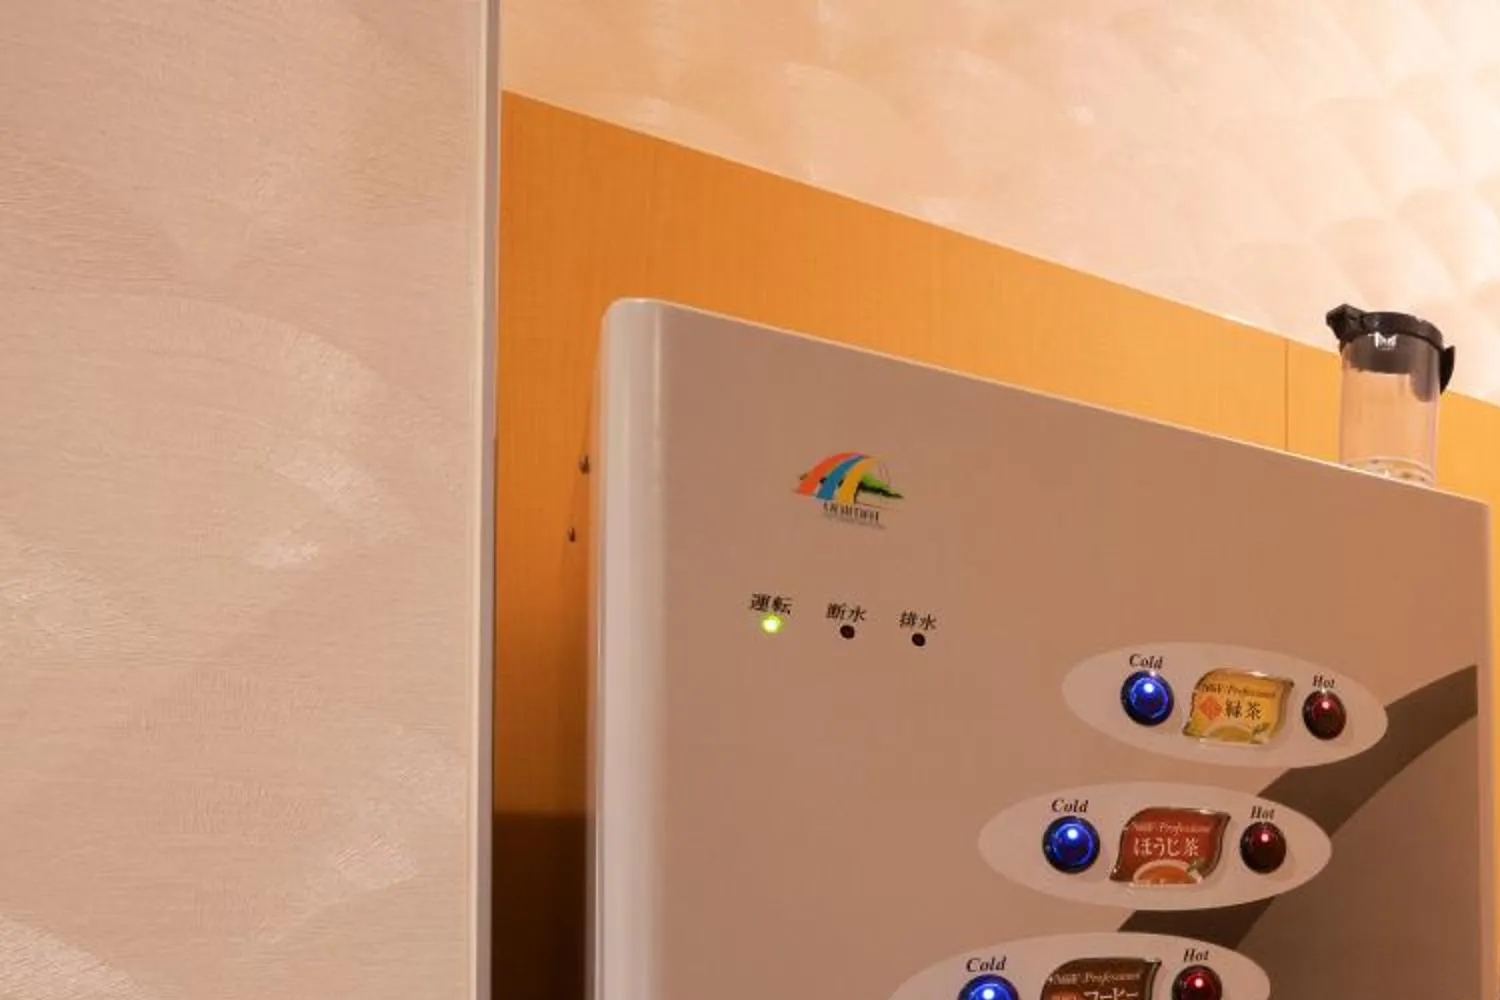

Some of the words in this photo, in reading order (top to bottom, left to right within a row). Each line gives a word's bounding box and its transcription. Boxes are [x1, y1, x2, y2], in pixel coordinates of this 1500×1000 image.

[748, 593, 793, 615] 運転
[826, 602, 868, 622] 断水
[899, 610, 938, 631] 排水
[1129, 653, 1163, 670] Cold
[1312, 675, 1336, 689] Hot
[1051, 799, 1089, 814] Cold
[1250, 805, 1275, 820] Hot
[1133, 837, 1200, 857] ほうじ茶
[1183, 948, 1209, 963] Hot
[966, 956, 1007, 973] Cold
